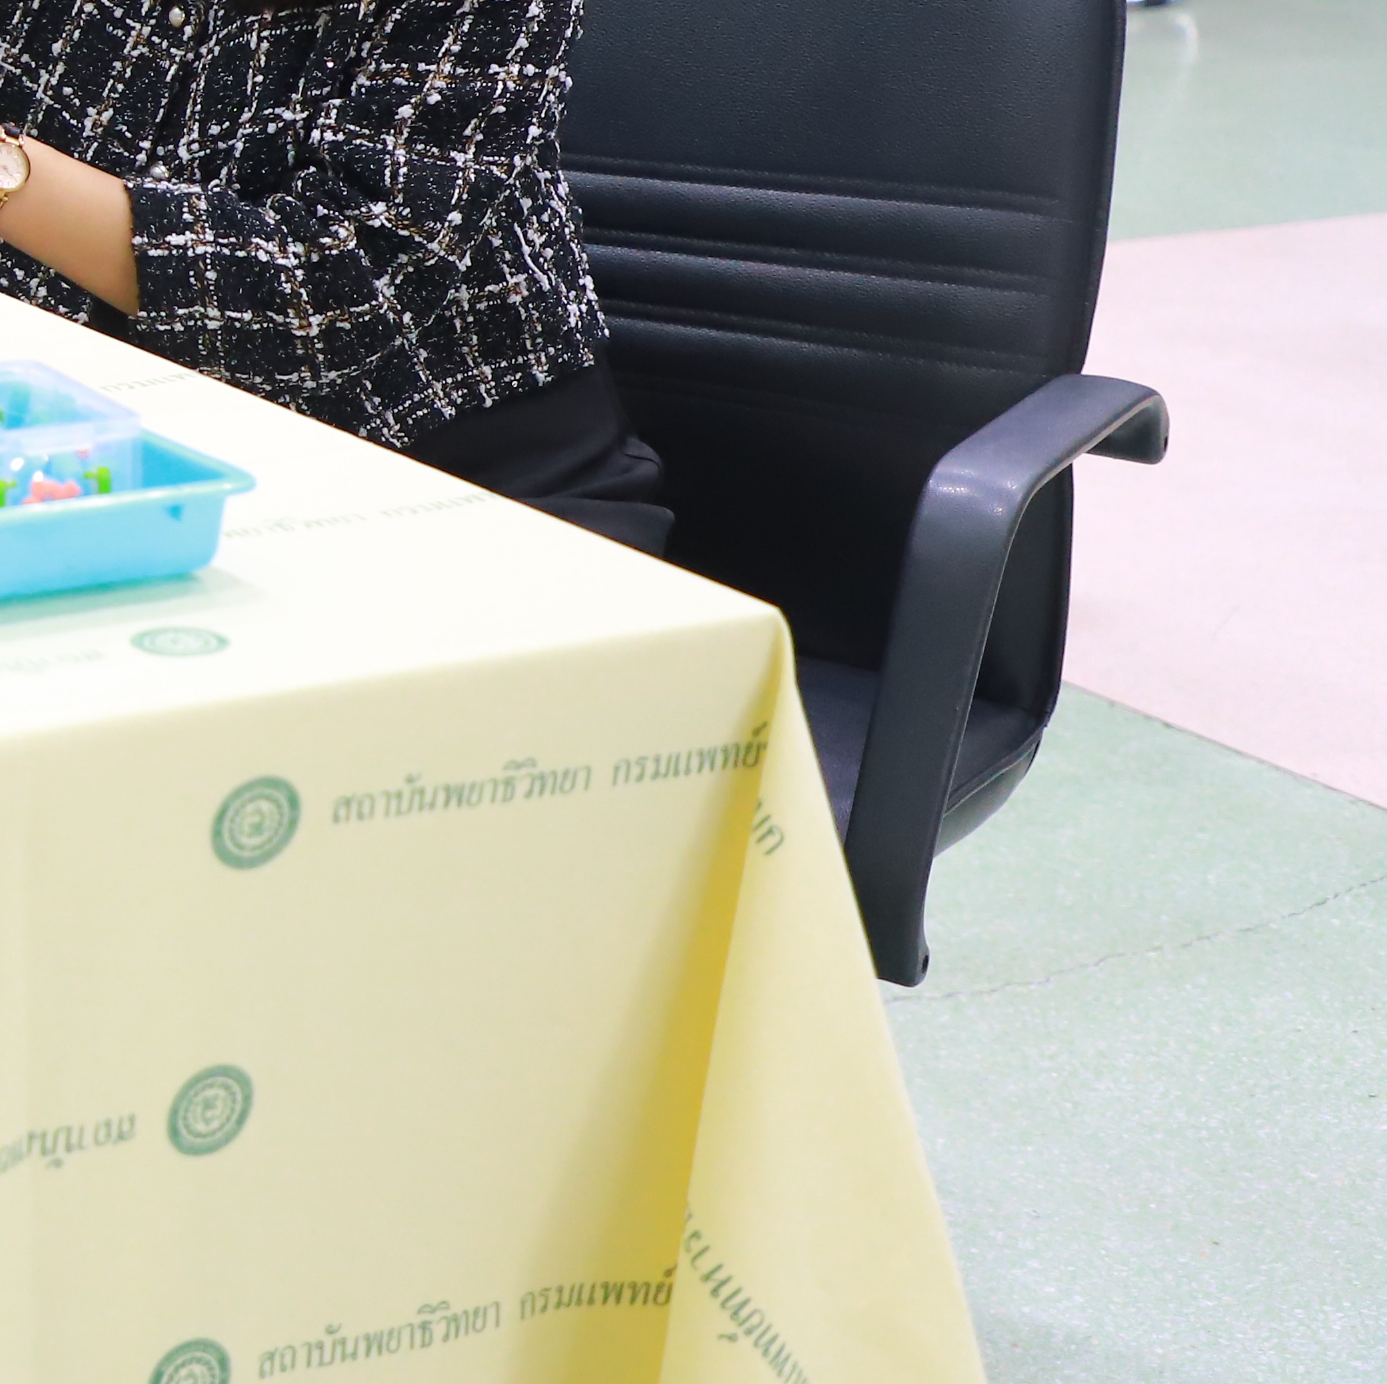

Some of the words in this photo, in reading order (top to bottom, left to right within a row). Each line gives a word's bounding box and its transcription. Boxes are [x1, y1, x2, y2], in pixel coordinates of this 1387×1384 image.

[330, 756, 593, 826] สถาบันพยาธิวิทยา
[256, 1296, 502, 1382] สถาบันพยาธิวิทยา
